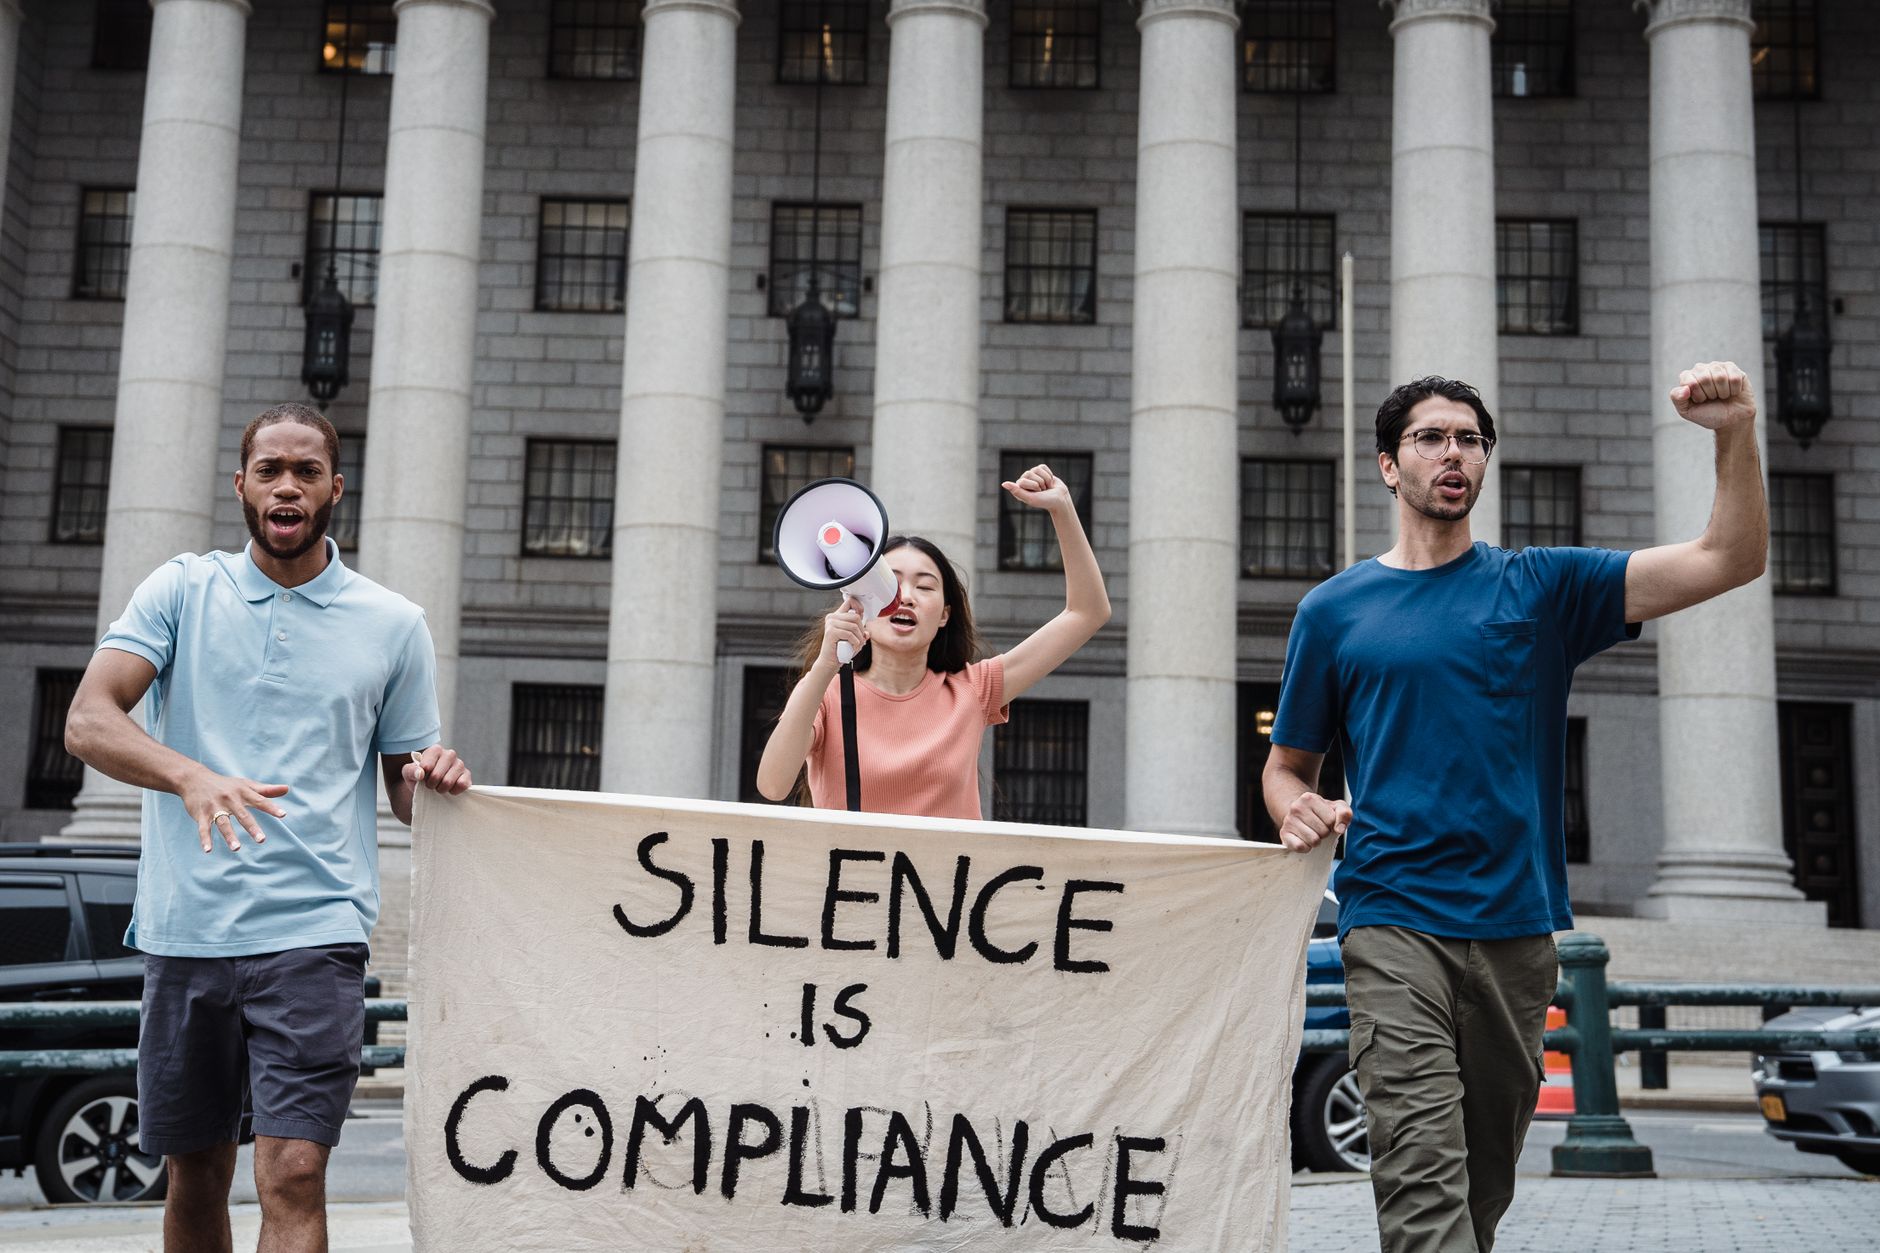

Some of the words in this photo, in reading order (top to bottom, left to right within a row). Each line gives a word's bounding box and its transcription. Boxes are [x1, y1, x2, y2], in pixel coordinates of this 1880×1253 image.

[612, 831, 1125, 974] SILENCE
[799, 983, 872, 1050] IS
[444, 1074, 1167, 1243] COMPLIANCE
